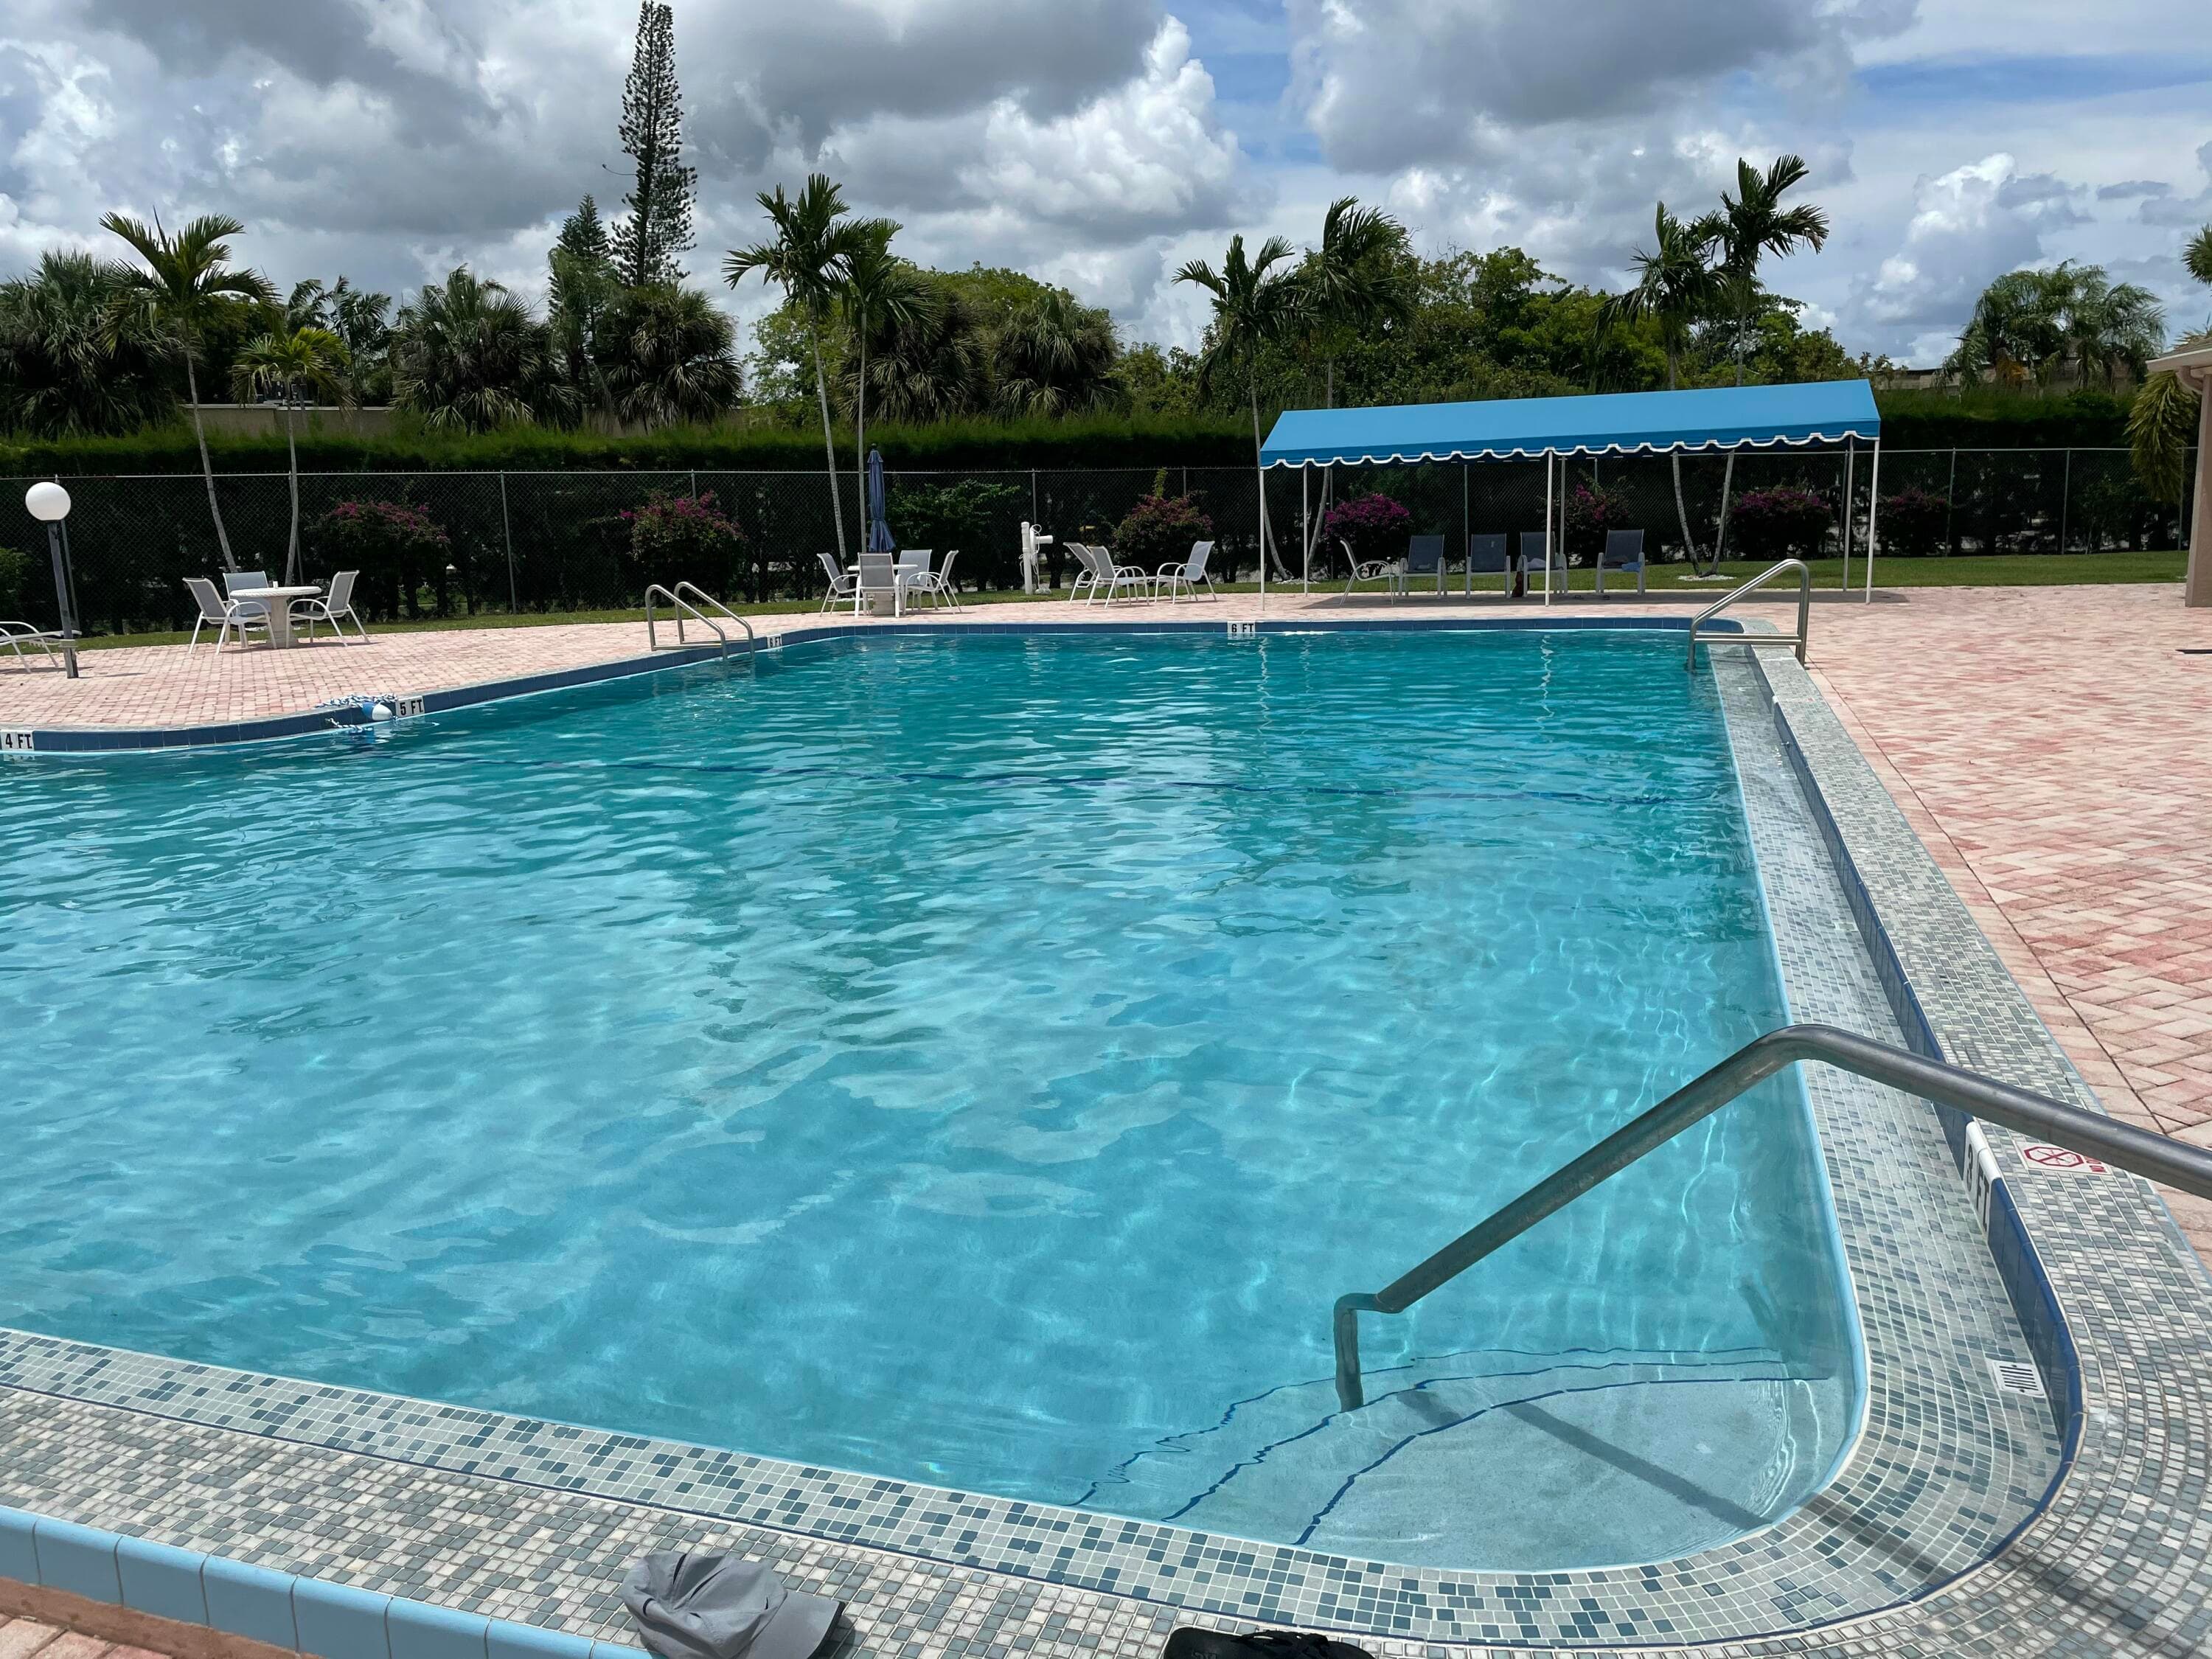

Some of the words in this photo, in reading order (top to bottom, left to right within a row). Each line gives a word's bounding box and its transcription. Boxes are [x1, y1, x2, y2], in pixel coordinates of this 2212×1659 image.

[1231, 623, 1237, 633] 6
[400, 701, 407, 716] 5
[5, 733, 13, 748] 4
[1966, 1144, 1974, 1192] 3
